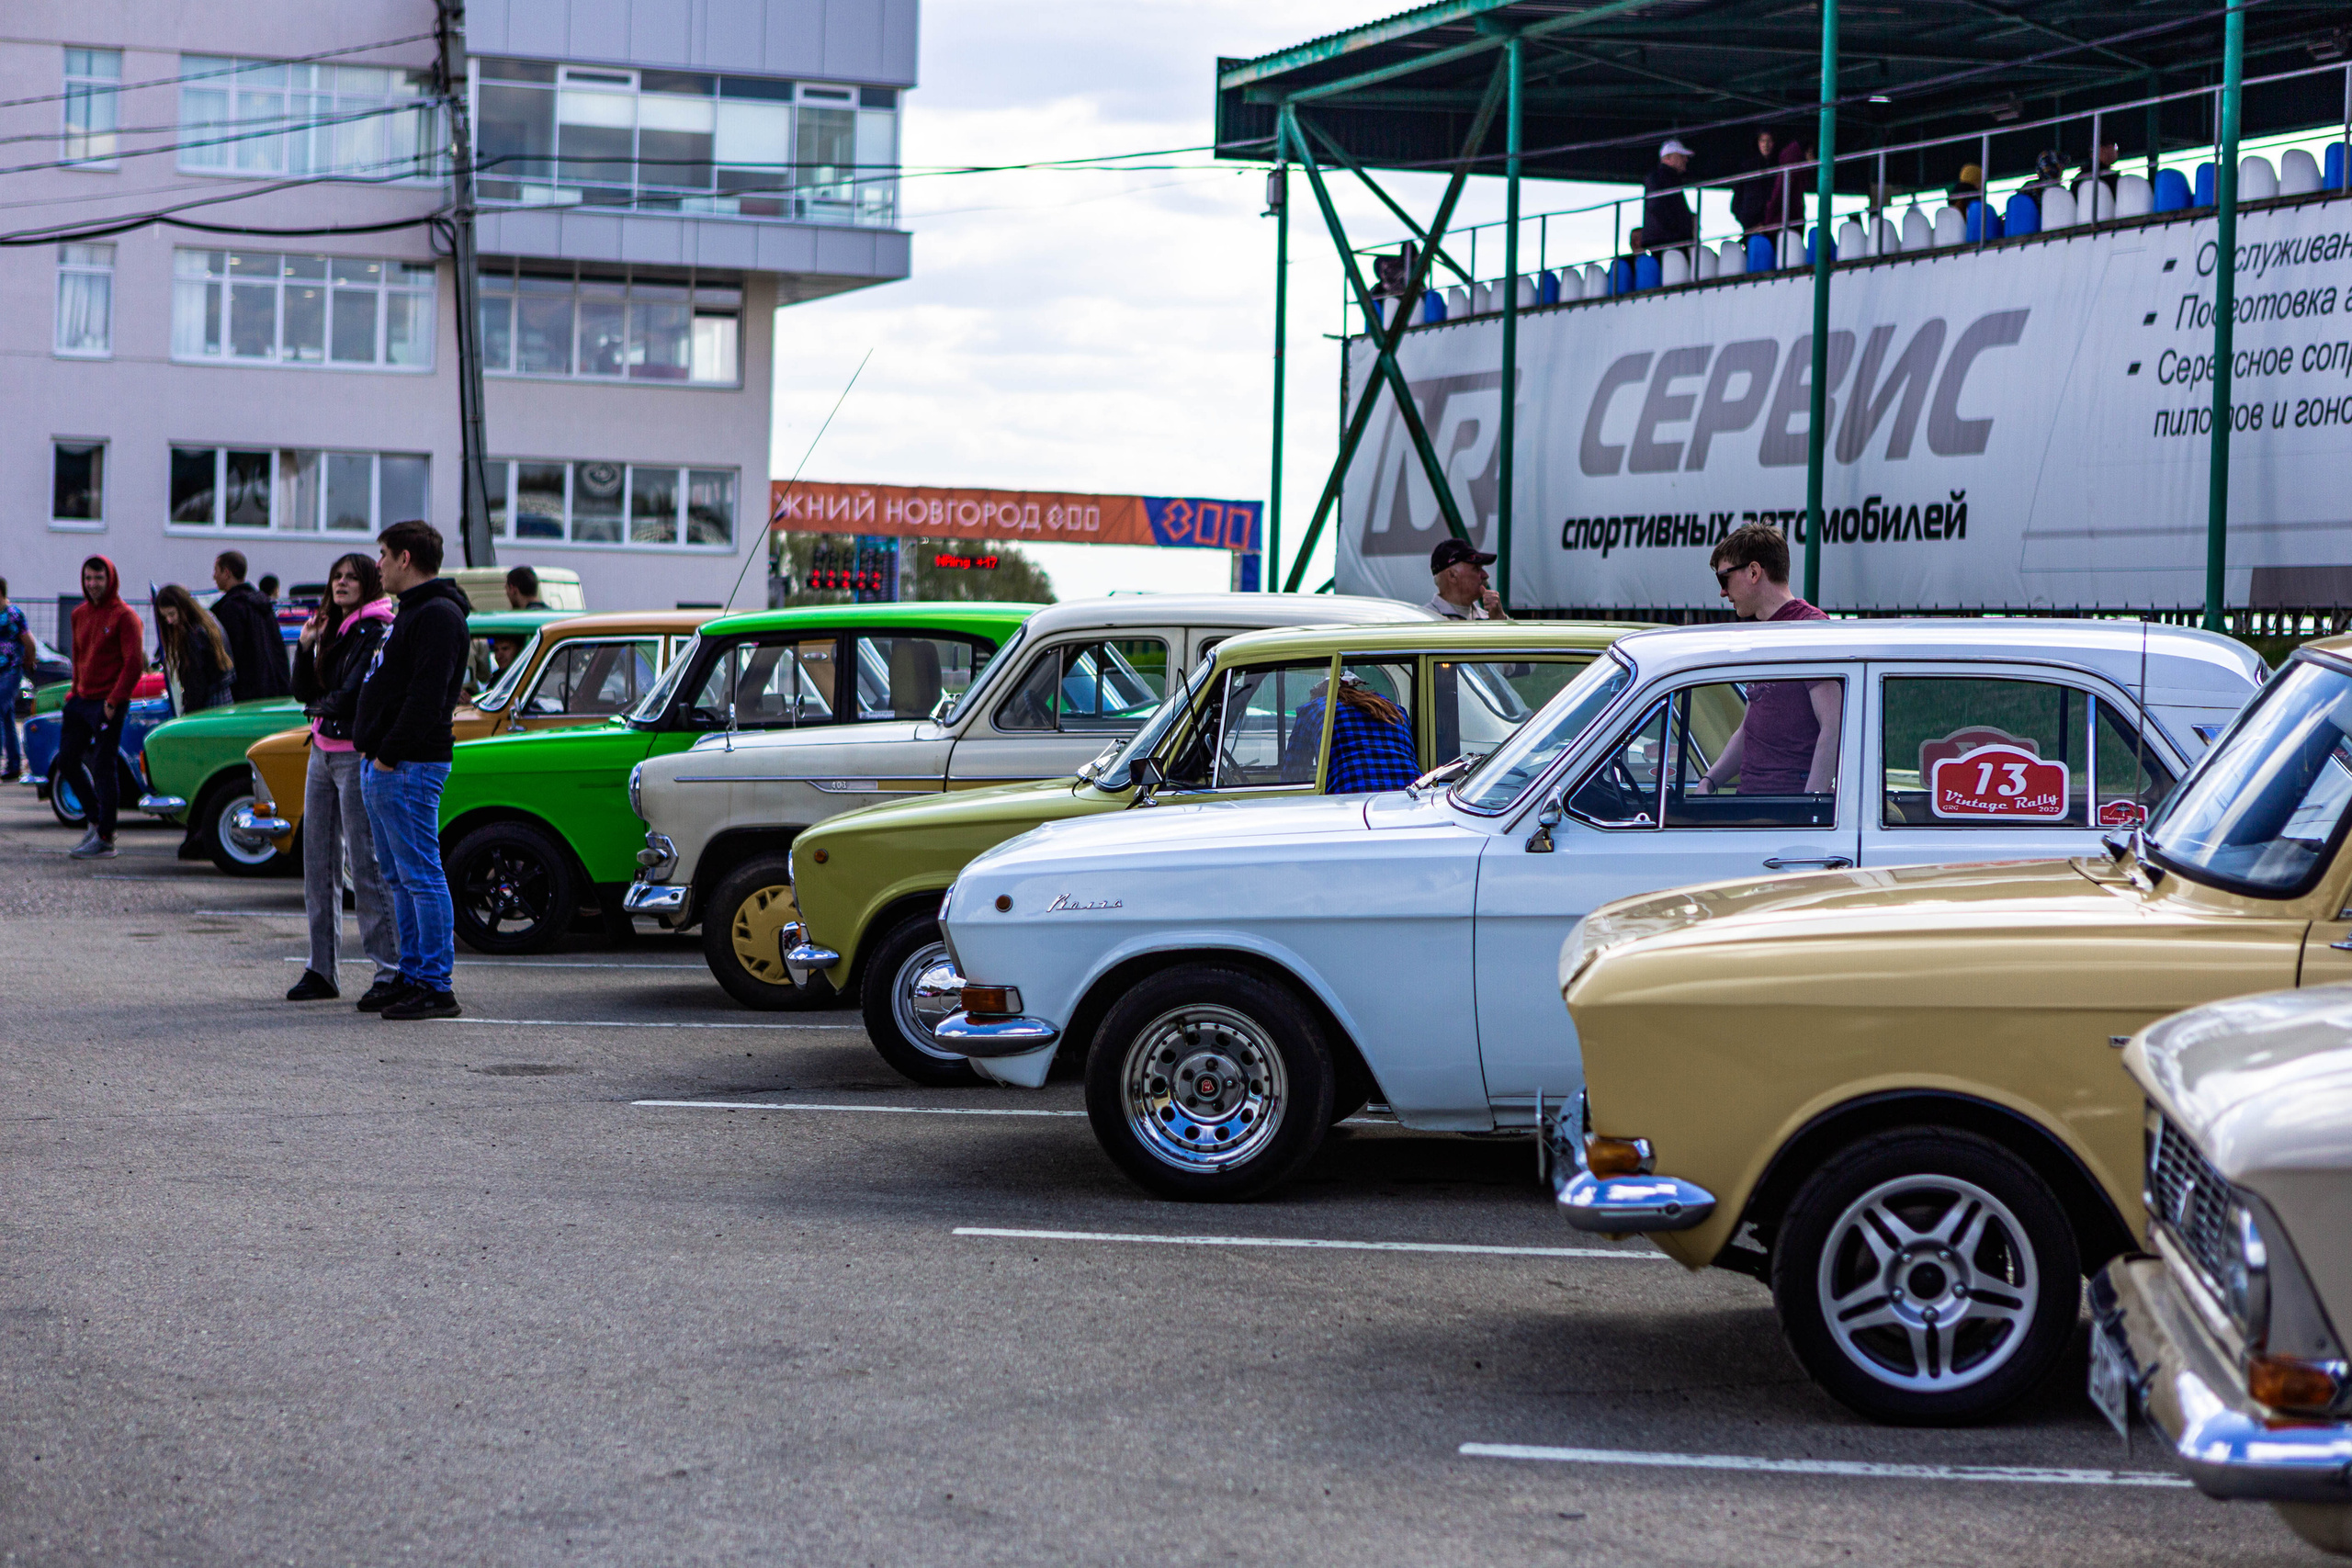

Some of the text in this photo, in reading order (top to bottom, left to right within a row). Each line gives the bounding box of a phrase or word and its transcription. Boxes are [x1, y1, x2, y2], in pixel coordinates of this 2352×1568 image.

[2197, 231, 2352, 279] Ослуживан
[1578, 309, 2031, 478] СЕРВИС
[2154, 401, 2264, 437] пилоов
[2272, 400, 2288, 430] и
[887, 497, 1042, 534] НОВГОРОД
[1562, 510, 1736, 559] спортивных
[1974, 761, 2029, 796] 13
[1945, 789, 2060, 812] Vintage Rally
